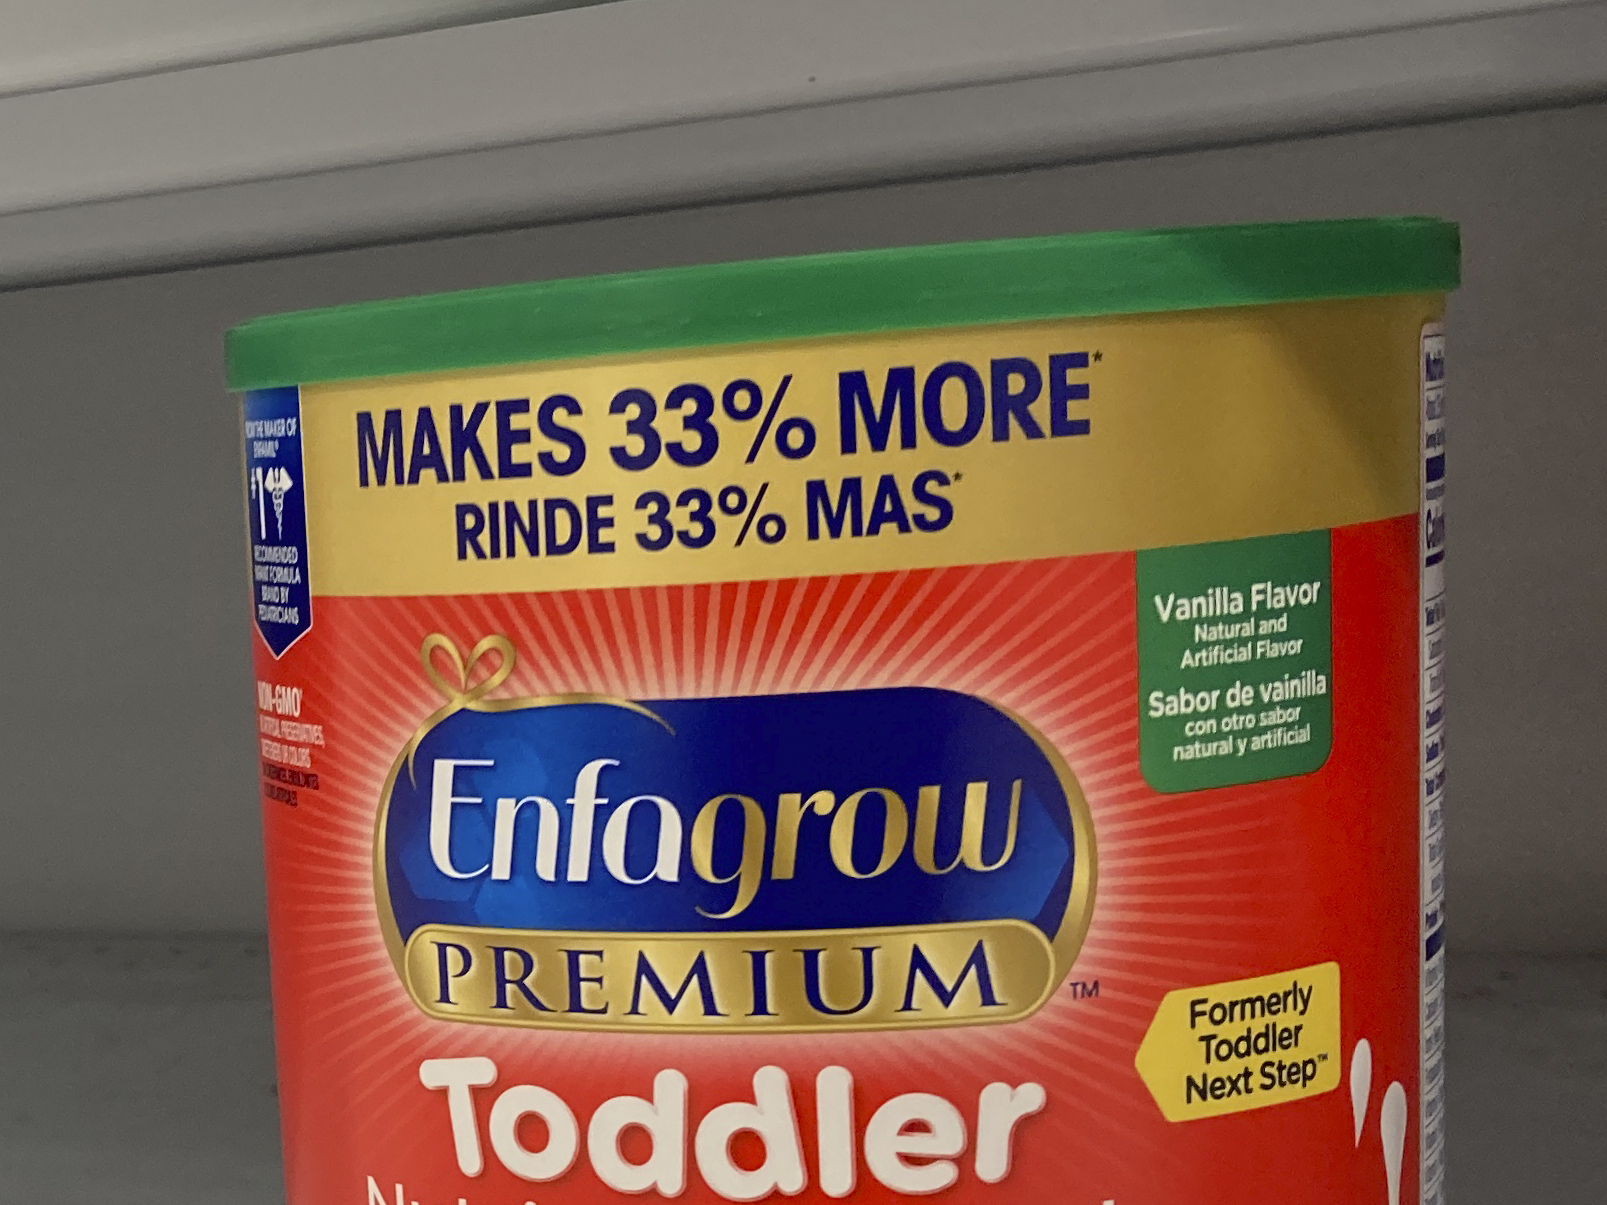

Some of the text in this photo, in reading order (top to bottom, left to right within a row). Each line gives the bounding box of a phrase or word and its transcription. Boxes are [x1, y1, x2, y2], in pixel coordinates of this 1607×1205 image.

[286, 417, 297, 437] OF
[355, 394, 587, 488] MAKES
[608, 373, 817, 472] 33%
[455, 494, 616, 562] RINDE
[633, 482, 787, 552] 33%
[1154, 580, 1321, 624] Vanilla Flavor
[1194, 612, 1288, 644] Natural and
[1180, 638, 1304, 670] Artificial Flavor
[1148, 669, 1327, 718] Sabor de vainilla
[1173, 723, 1311, 762] natural y artificial
[1185, 705, 1302, 738] con otro sabor
[429, 758, 1022, 920] Enfagrow
[431, 939, 1009, 1019] PREMIUM
[1189, 980, 1313, 1029] Formerly
[1198, 1021, 1303, 1064] Toddler
[1185, 1066, 1253, 1104] Next
[418, 1055, 1048, 1203] Toddler
